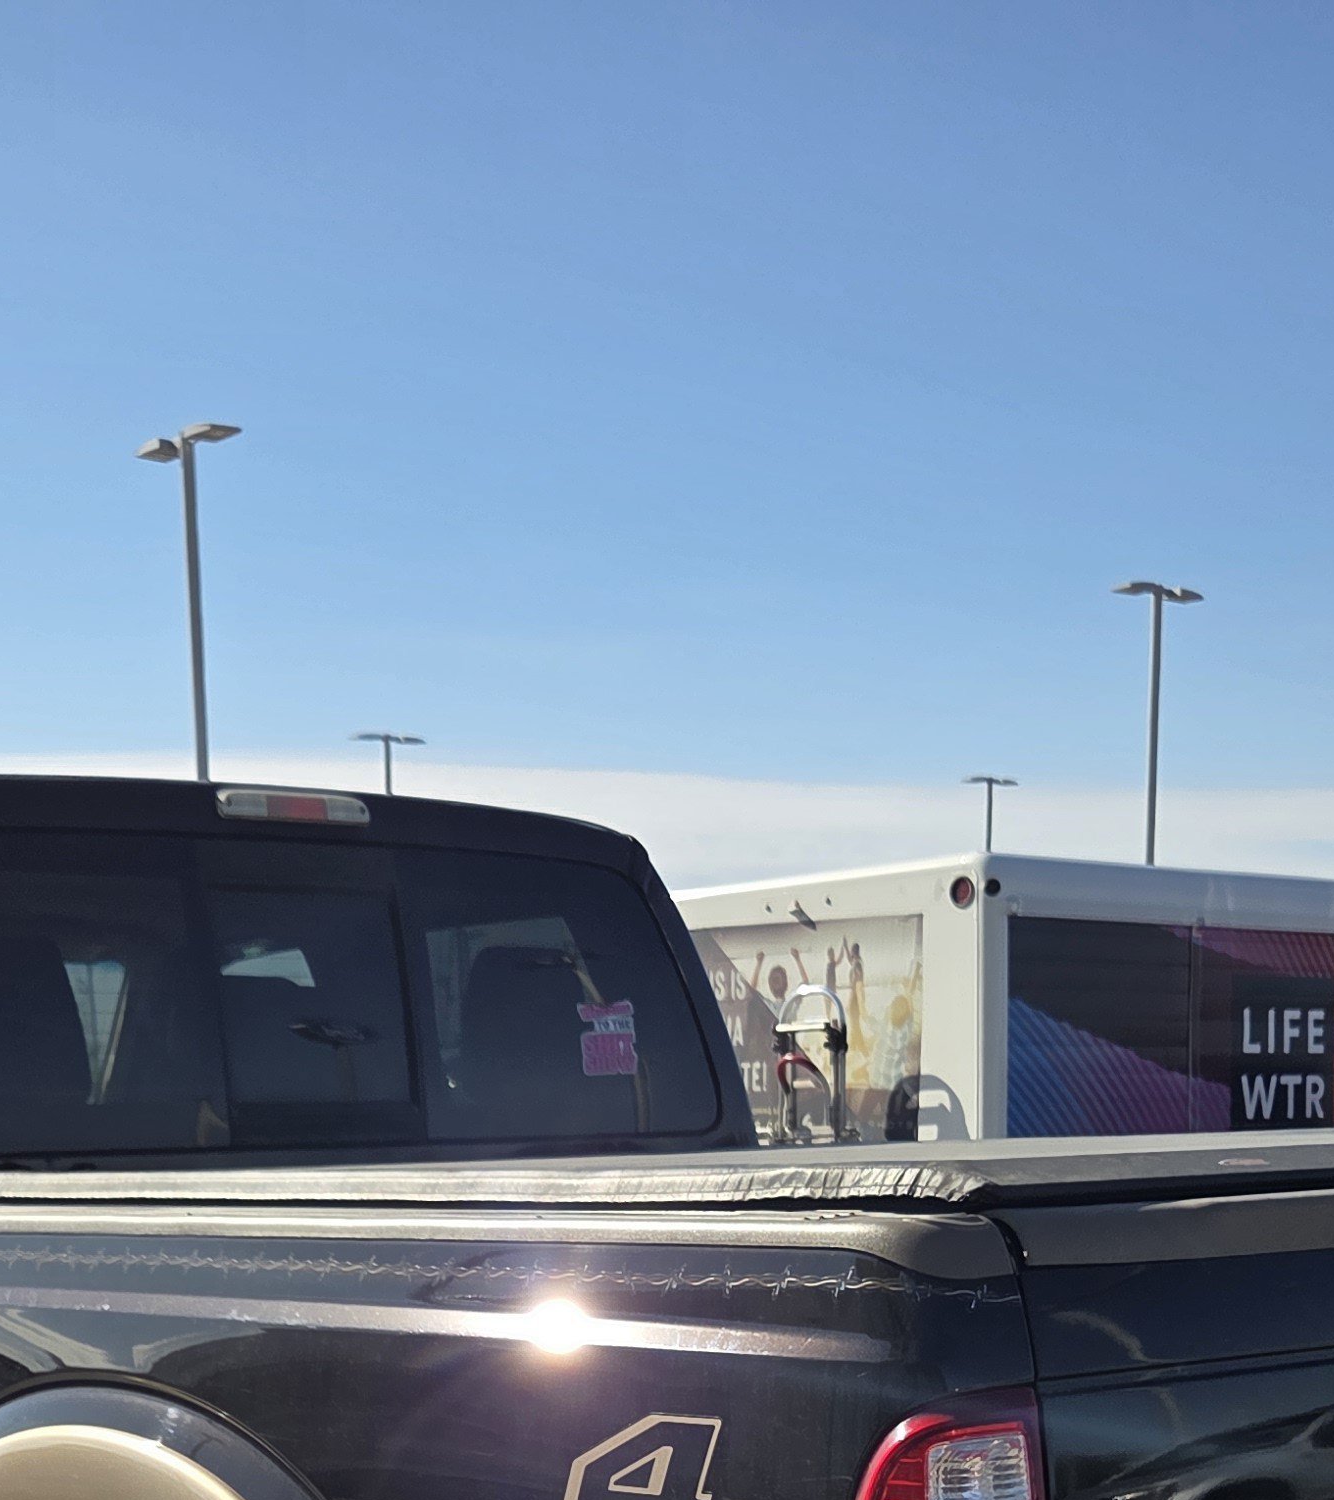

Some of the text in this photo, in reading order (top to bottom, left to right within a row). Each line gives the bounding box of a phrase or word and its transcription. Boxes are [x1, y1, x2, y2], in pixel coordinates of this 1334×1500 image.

[731, 969, 747, 1001] IS
[1242, 1007, 1325, 1054] LIFE
[1241, 1074, 1325, 1119] WTR
